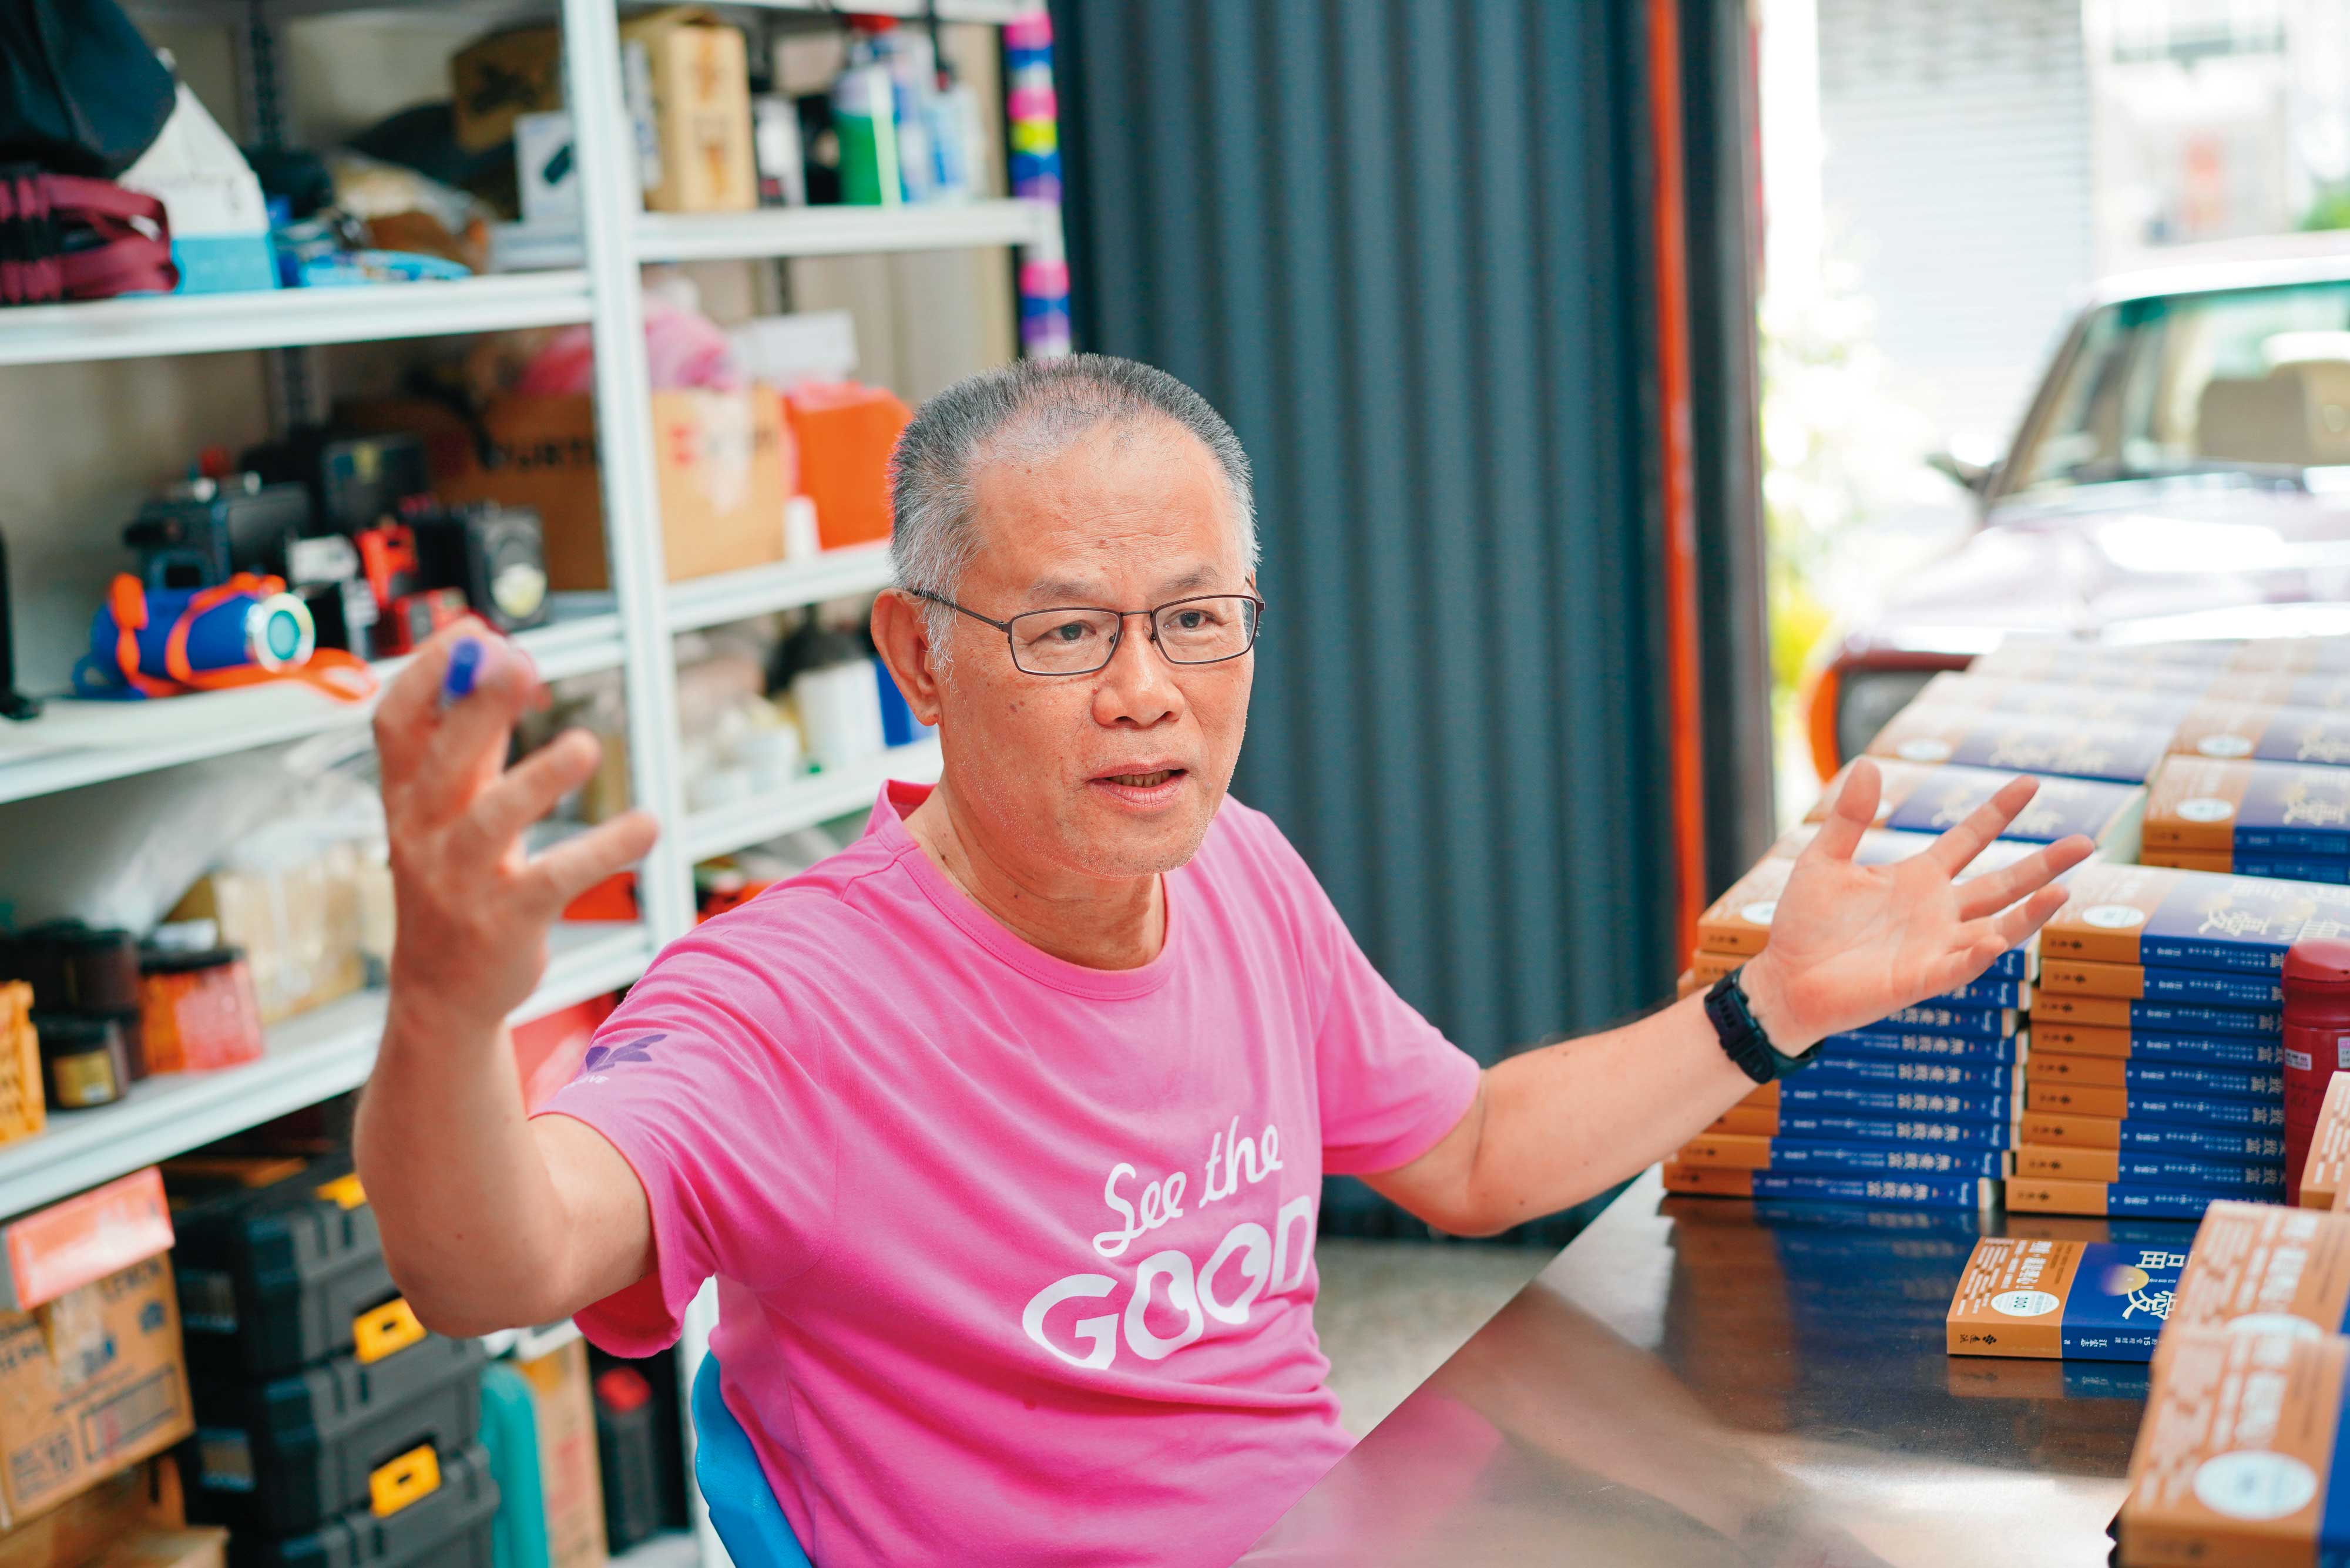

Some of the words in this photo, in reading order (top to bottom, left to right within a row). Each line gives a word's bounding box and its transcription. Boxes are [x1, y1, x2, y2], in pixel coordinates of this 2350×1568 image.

[1093, 1163, 1186, 1257] See
[1198, 1115, 1283, 1208] the
[1022, 1195, 1311, 1369] GOOD
